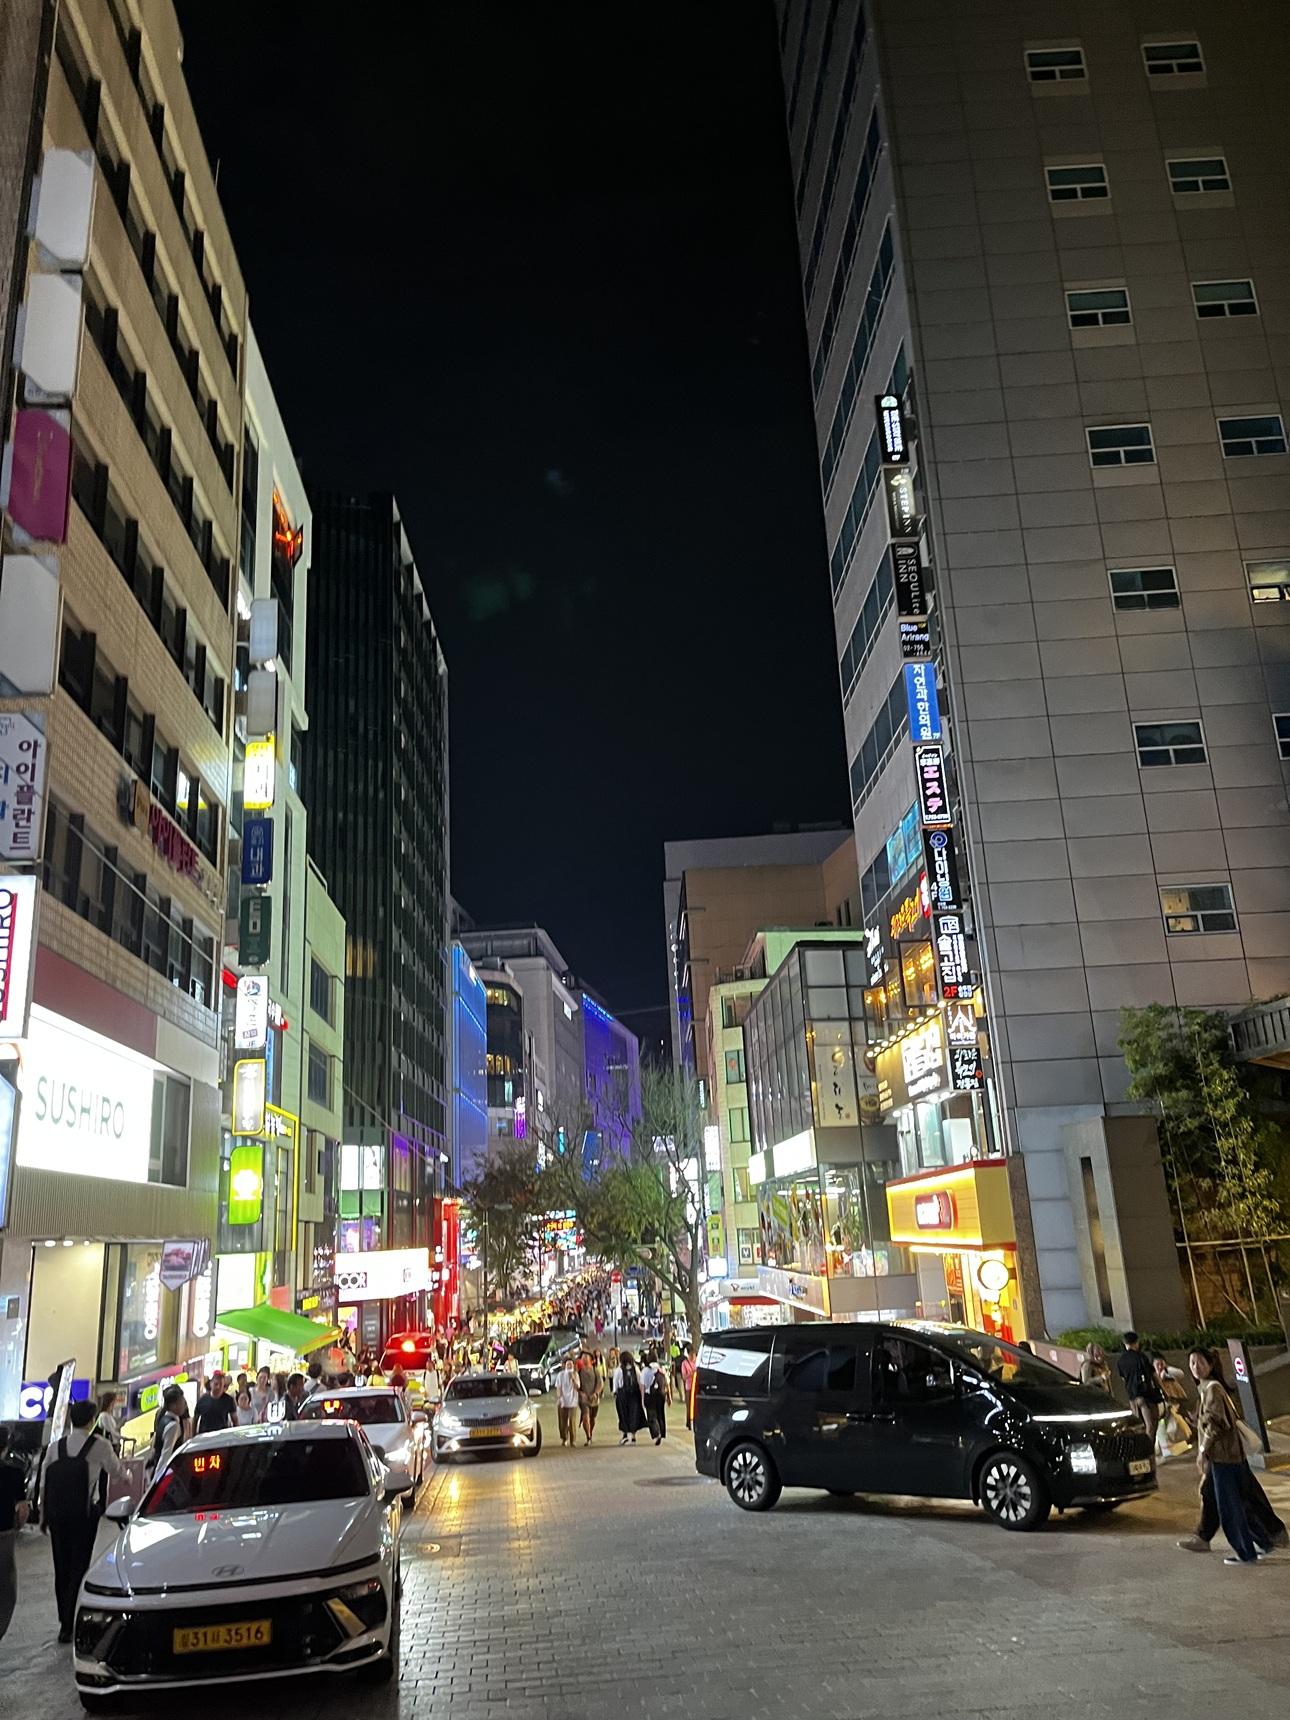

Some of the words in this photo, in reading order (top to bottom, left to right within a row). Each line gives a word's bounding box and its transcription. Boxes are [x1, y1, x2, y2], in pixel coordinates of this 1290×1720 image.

[898, 559, 909, 583] INN
[900, 623, 918, 632] Blue
[901, 633, 930, 642] Arirang
[913, 664, 933, 741] 자연과한의원
[9, 739, 41, 851] 아이플란트
[923, 766, 943, 813] エステ
[937, 934, 957, 983] 술고집
[943, 986, 958, 998] 2F
[35, 1075, 125, 1140] SUSHIRO
[194, 1457, 205, 1472] 빈
[209, 1454, 221, 1469] 차
[224, 1624, 264, 1646] 3516
